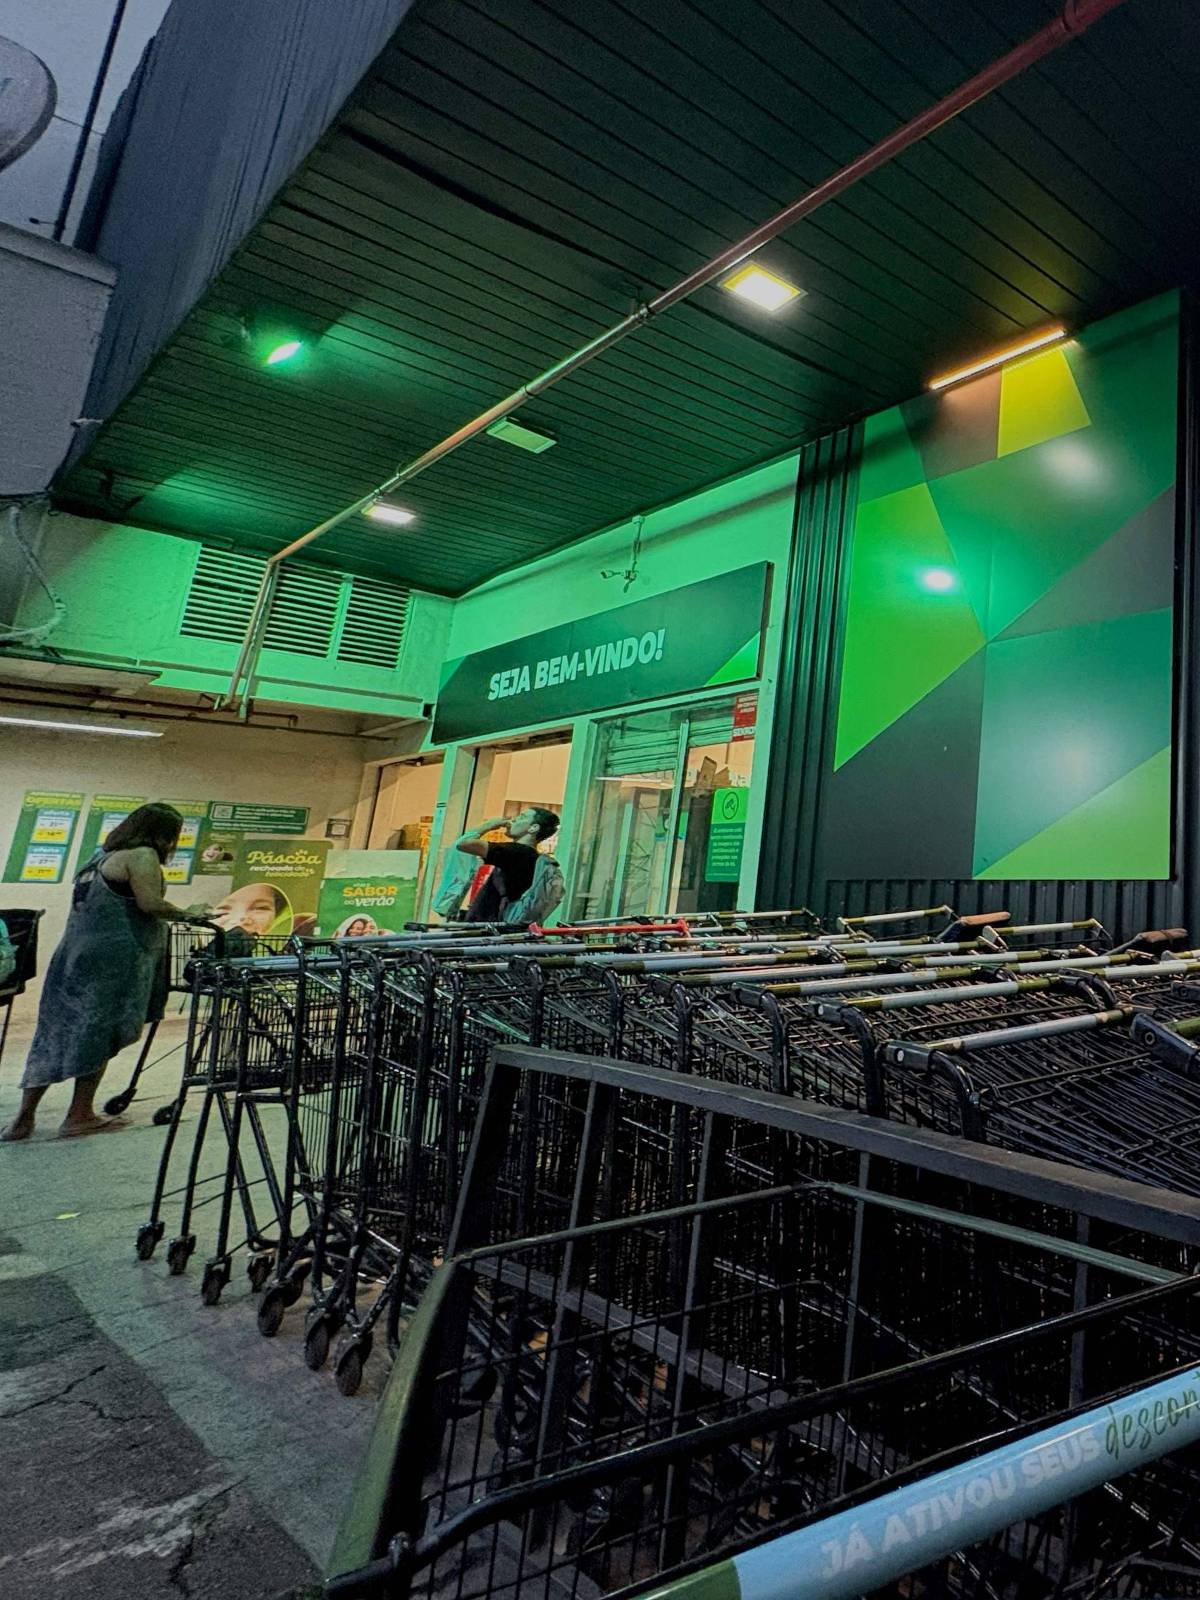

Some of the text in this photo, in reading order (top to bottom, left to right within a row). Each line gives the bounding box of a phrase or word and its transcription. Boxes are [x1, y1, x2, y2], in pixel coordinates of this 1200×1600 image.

[488, 628, 665, 700] SEJA BEM-VINDO!
[343, 885, 398, 897] SABOR
[354, 896, 395, 907] verão
[819, 1521, 874, 1578] JÁ
[881, 1463, 1017, 1552] ATIVOU
[1020, 1428, 1099, 1486] SEUS
